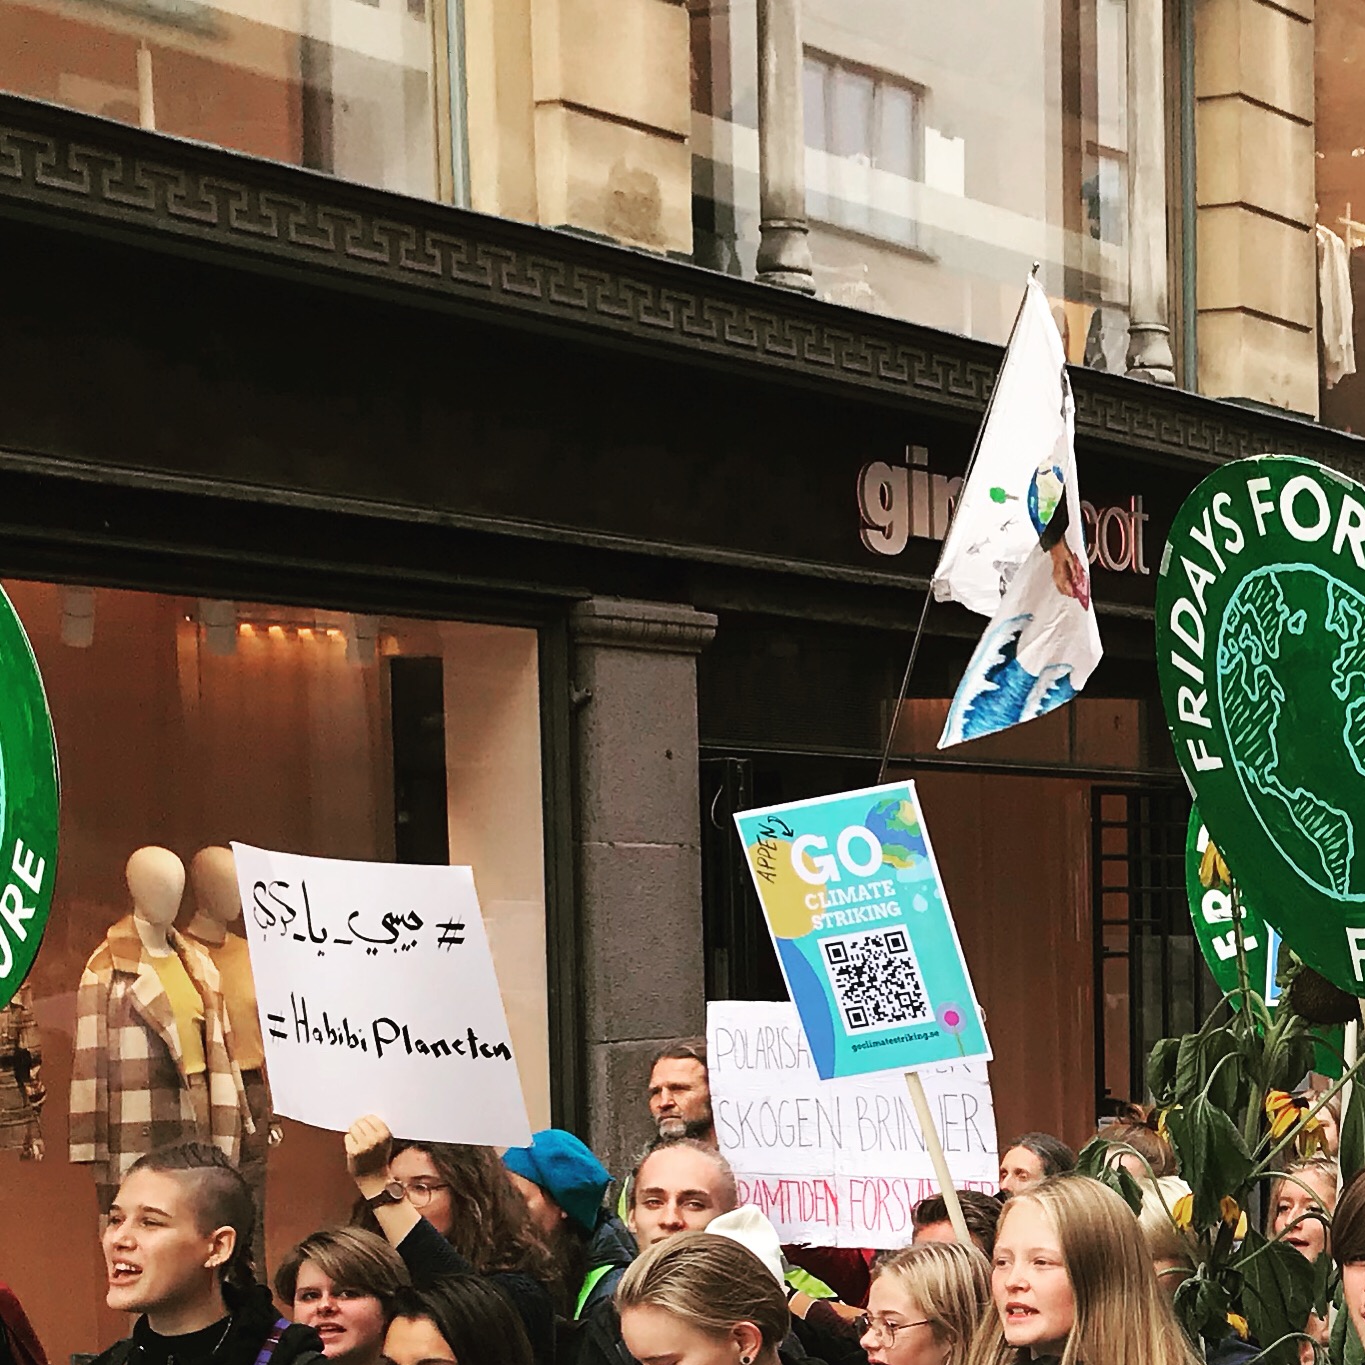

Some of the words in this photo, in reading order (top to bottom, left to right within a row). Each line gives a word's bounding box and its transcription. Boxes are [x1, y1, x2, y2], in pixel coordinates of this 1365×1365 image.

[858, 445, 965, 556] gin
[1169, 491, 1245, 772] FRIDAYS
[790, 824, 883, 885] GO
[804, 879, 897, 911] CLIMATE
[811, 900, 903, 931] STRIKING
[715, 1027, 811, 1073] POLARISA
[851, 1030, 940, 1053] goclimatestriking.se
[718, 1097, 843, 1150] SKOGEN
[856, 1093, 988, 1153] BRINER
